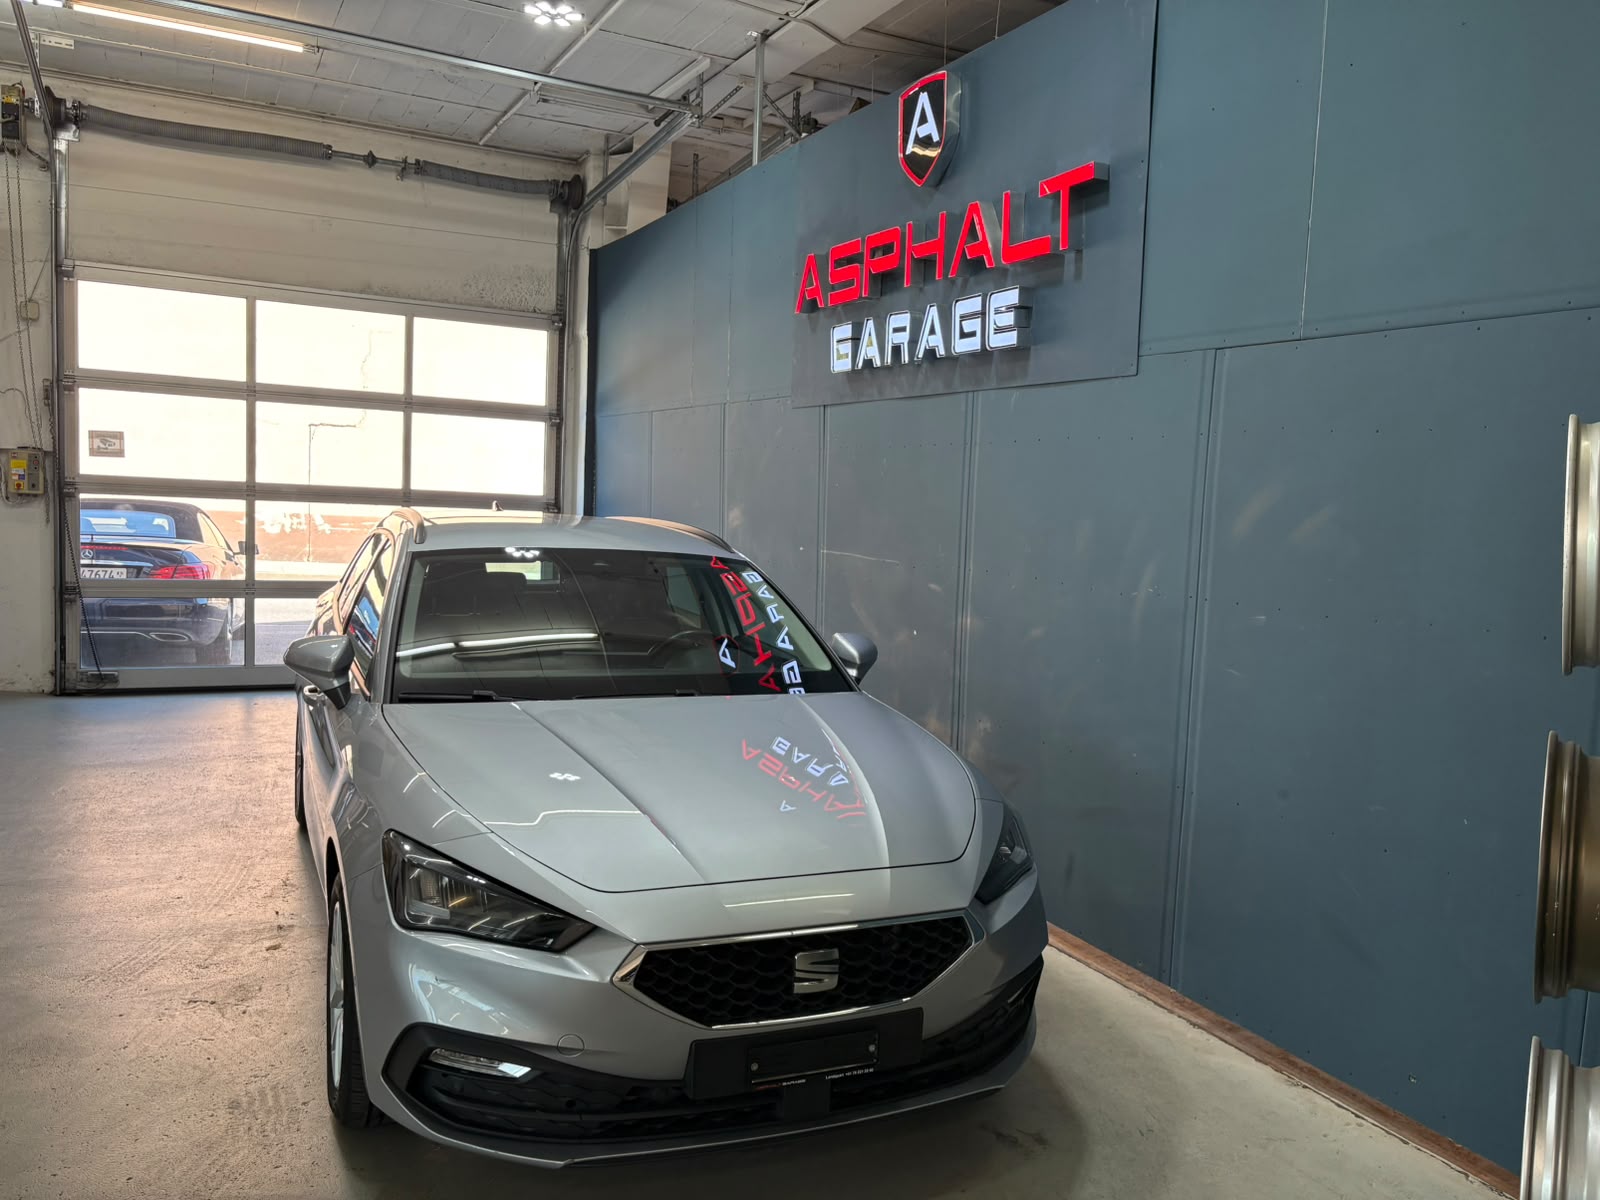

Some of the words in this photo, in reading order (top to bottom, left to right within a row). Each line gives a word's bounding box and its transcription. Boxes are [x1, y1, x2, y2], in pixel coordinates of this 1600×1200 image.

[905, 92, 940, 155] A
[794, 161, 1095, 314] ASPHALT
[831, 285, 1021, 374] GARAGE
